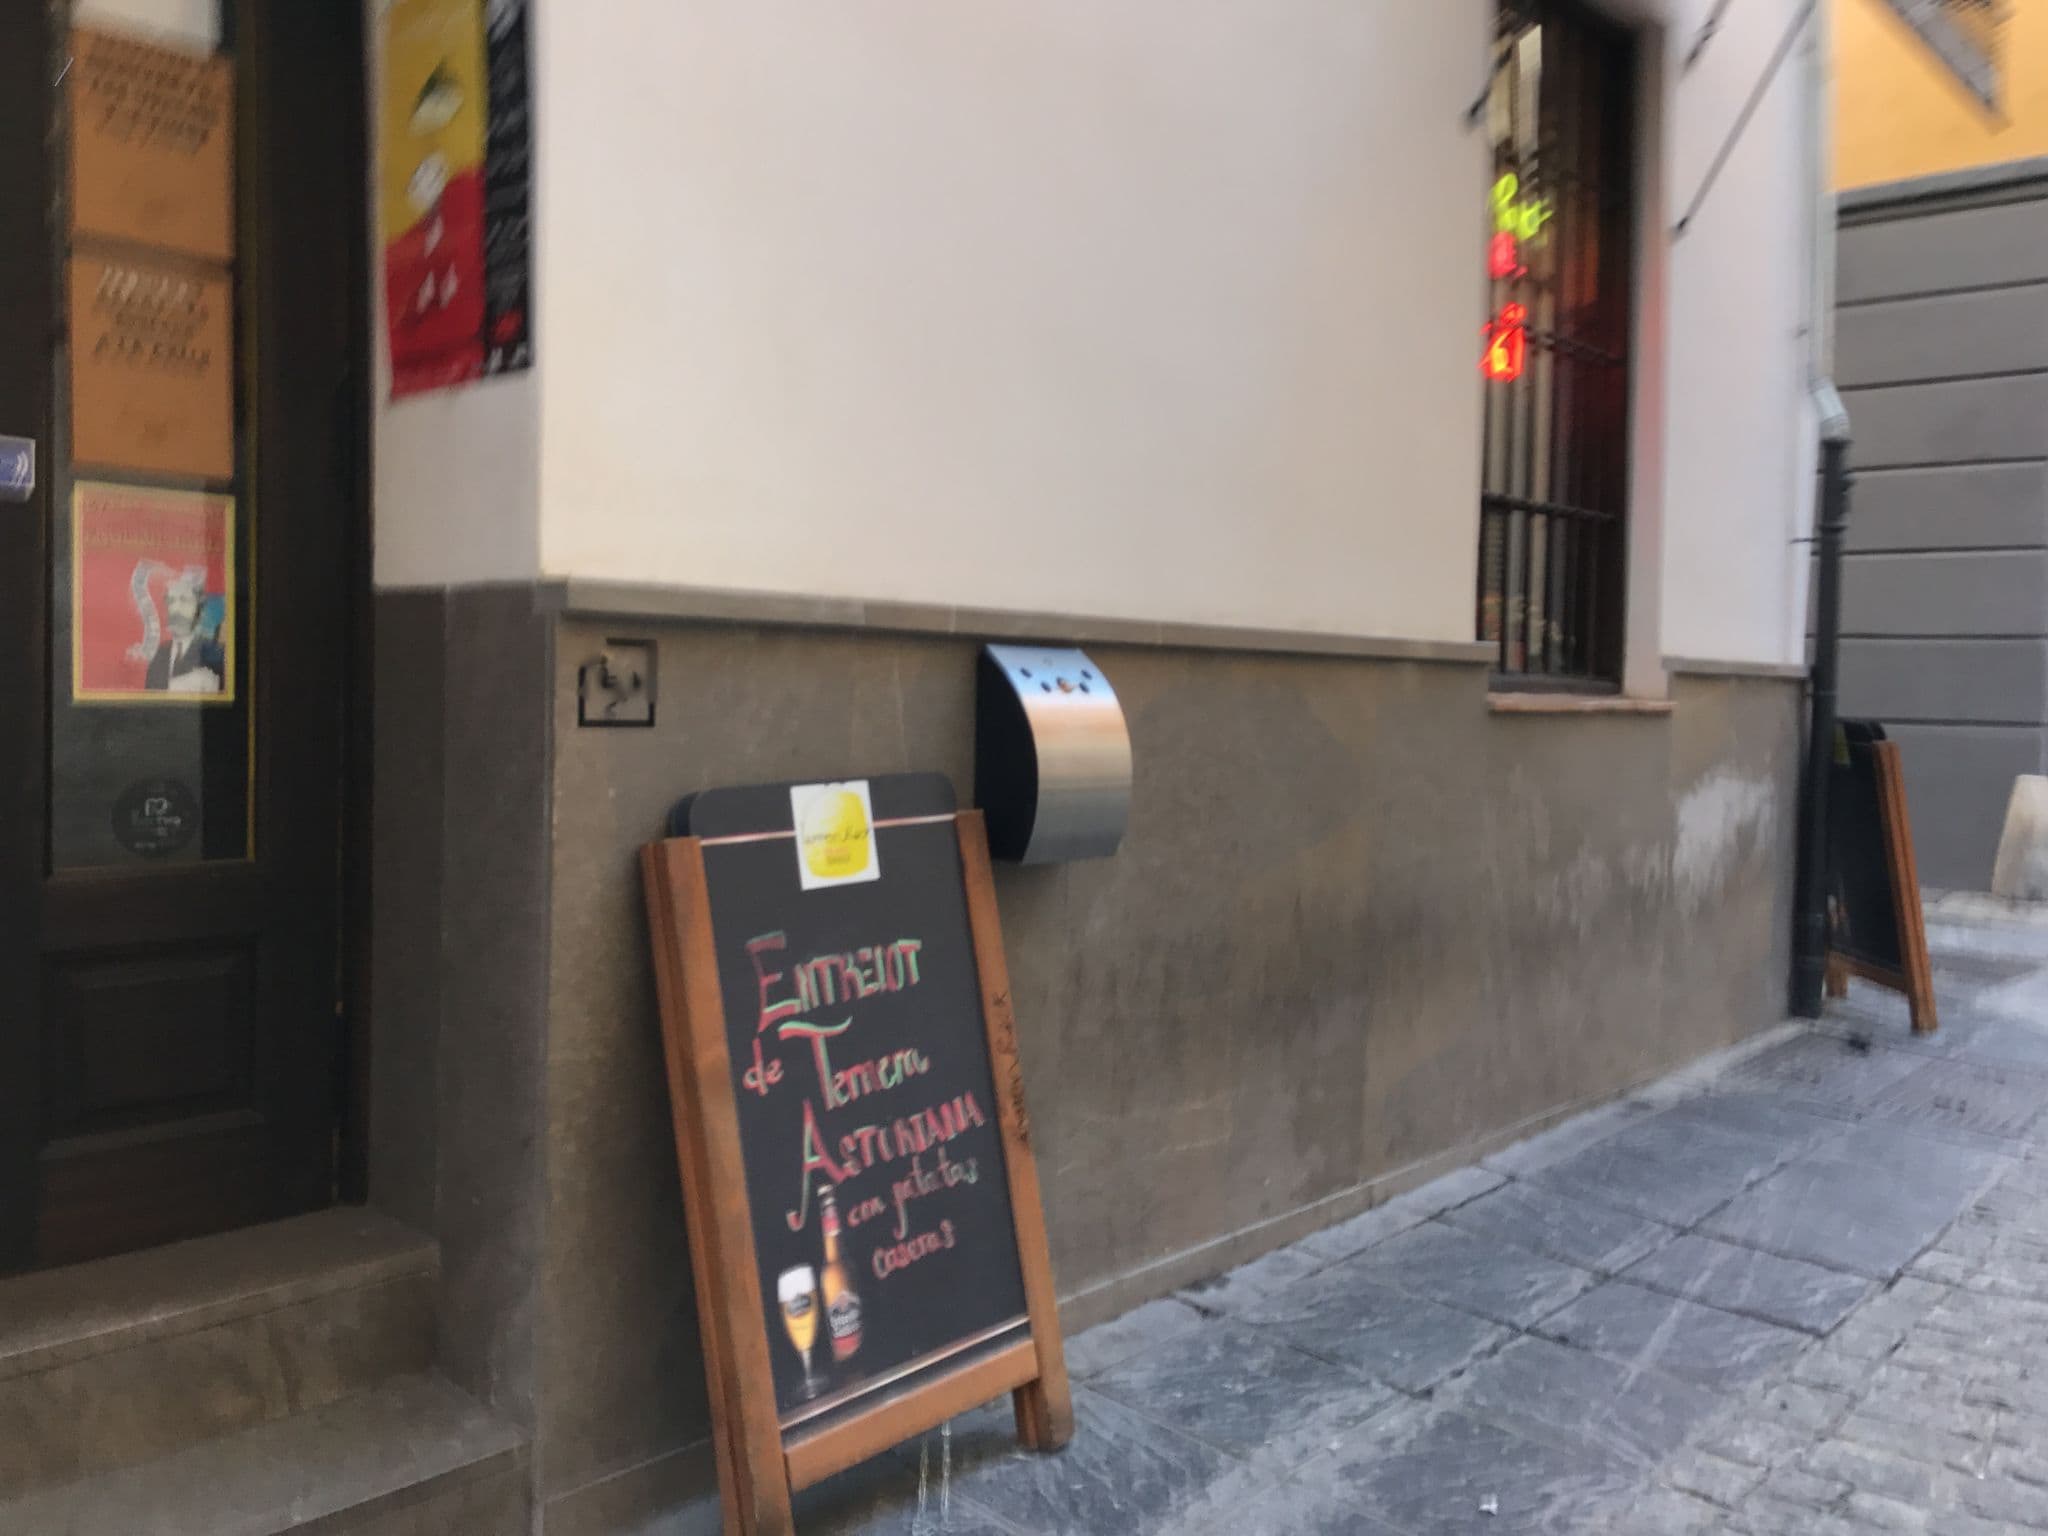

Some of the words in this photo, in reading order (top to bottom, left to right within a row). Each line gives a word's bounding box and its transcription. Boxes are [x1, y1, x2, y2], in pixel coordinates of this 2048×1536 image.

[742, 1037, 785, 1097] de
[778, 1015, 931, 1111] Ternera
[847, 1196, 888, 1227] con
